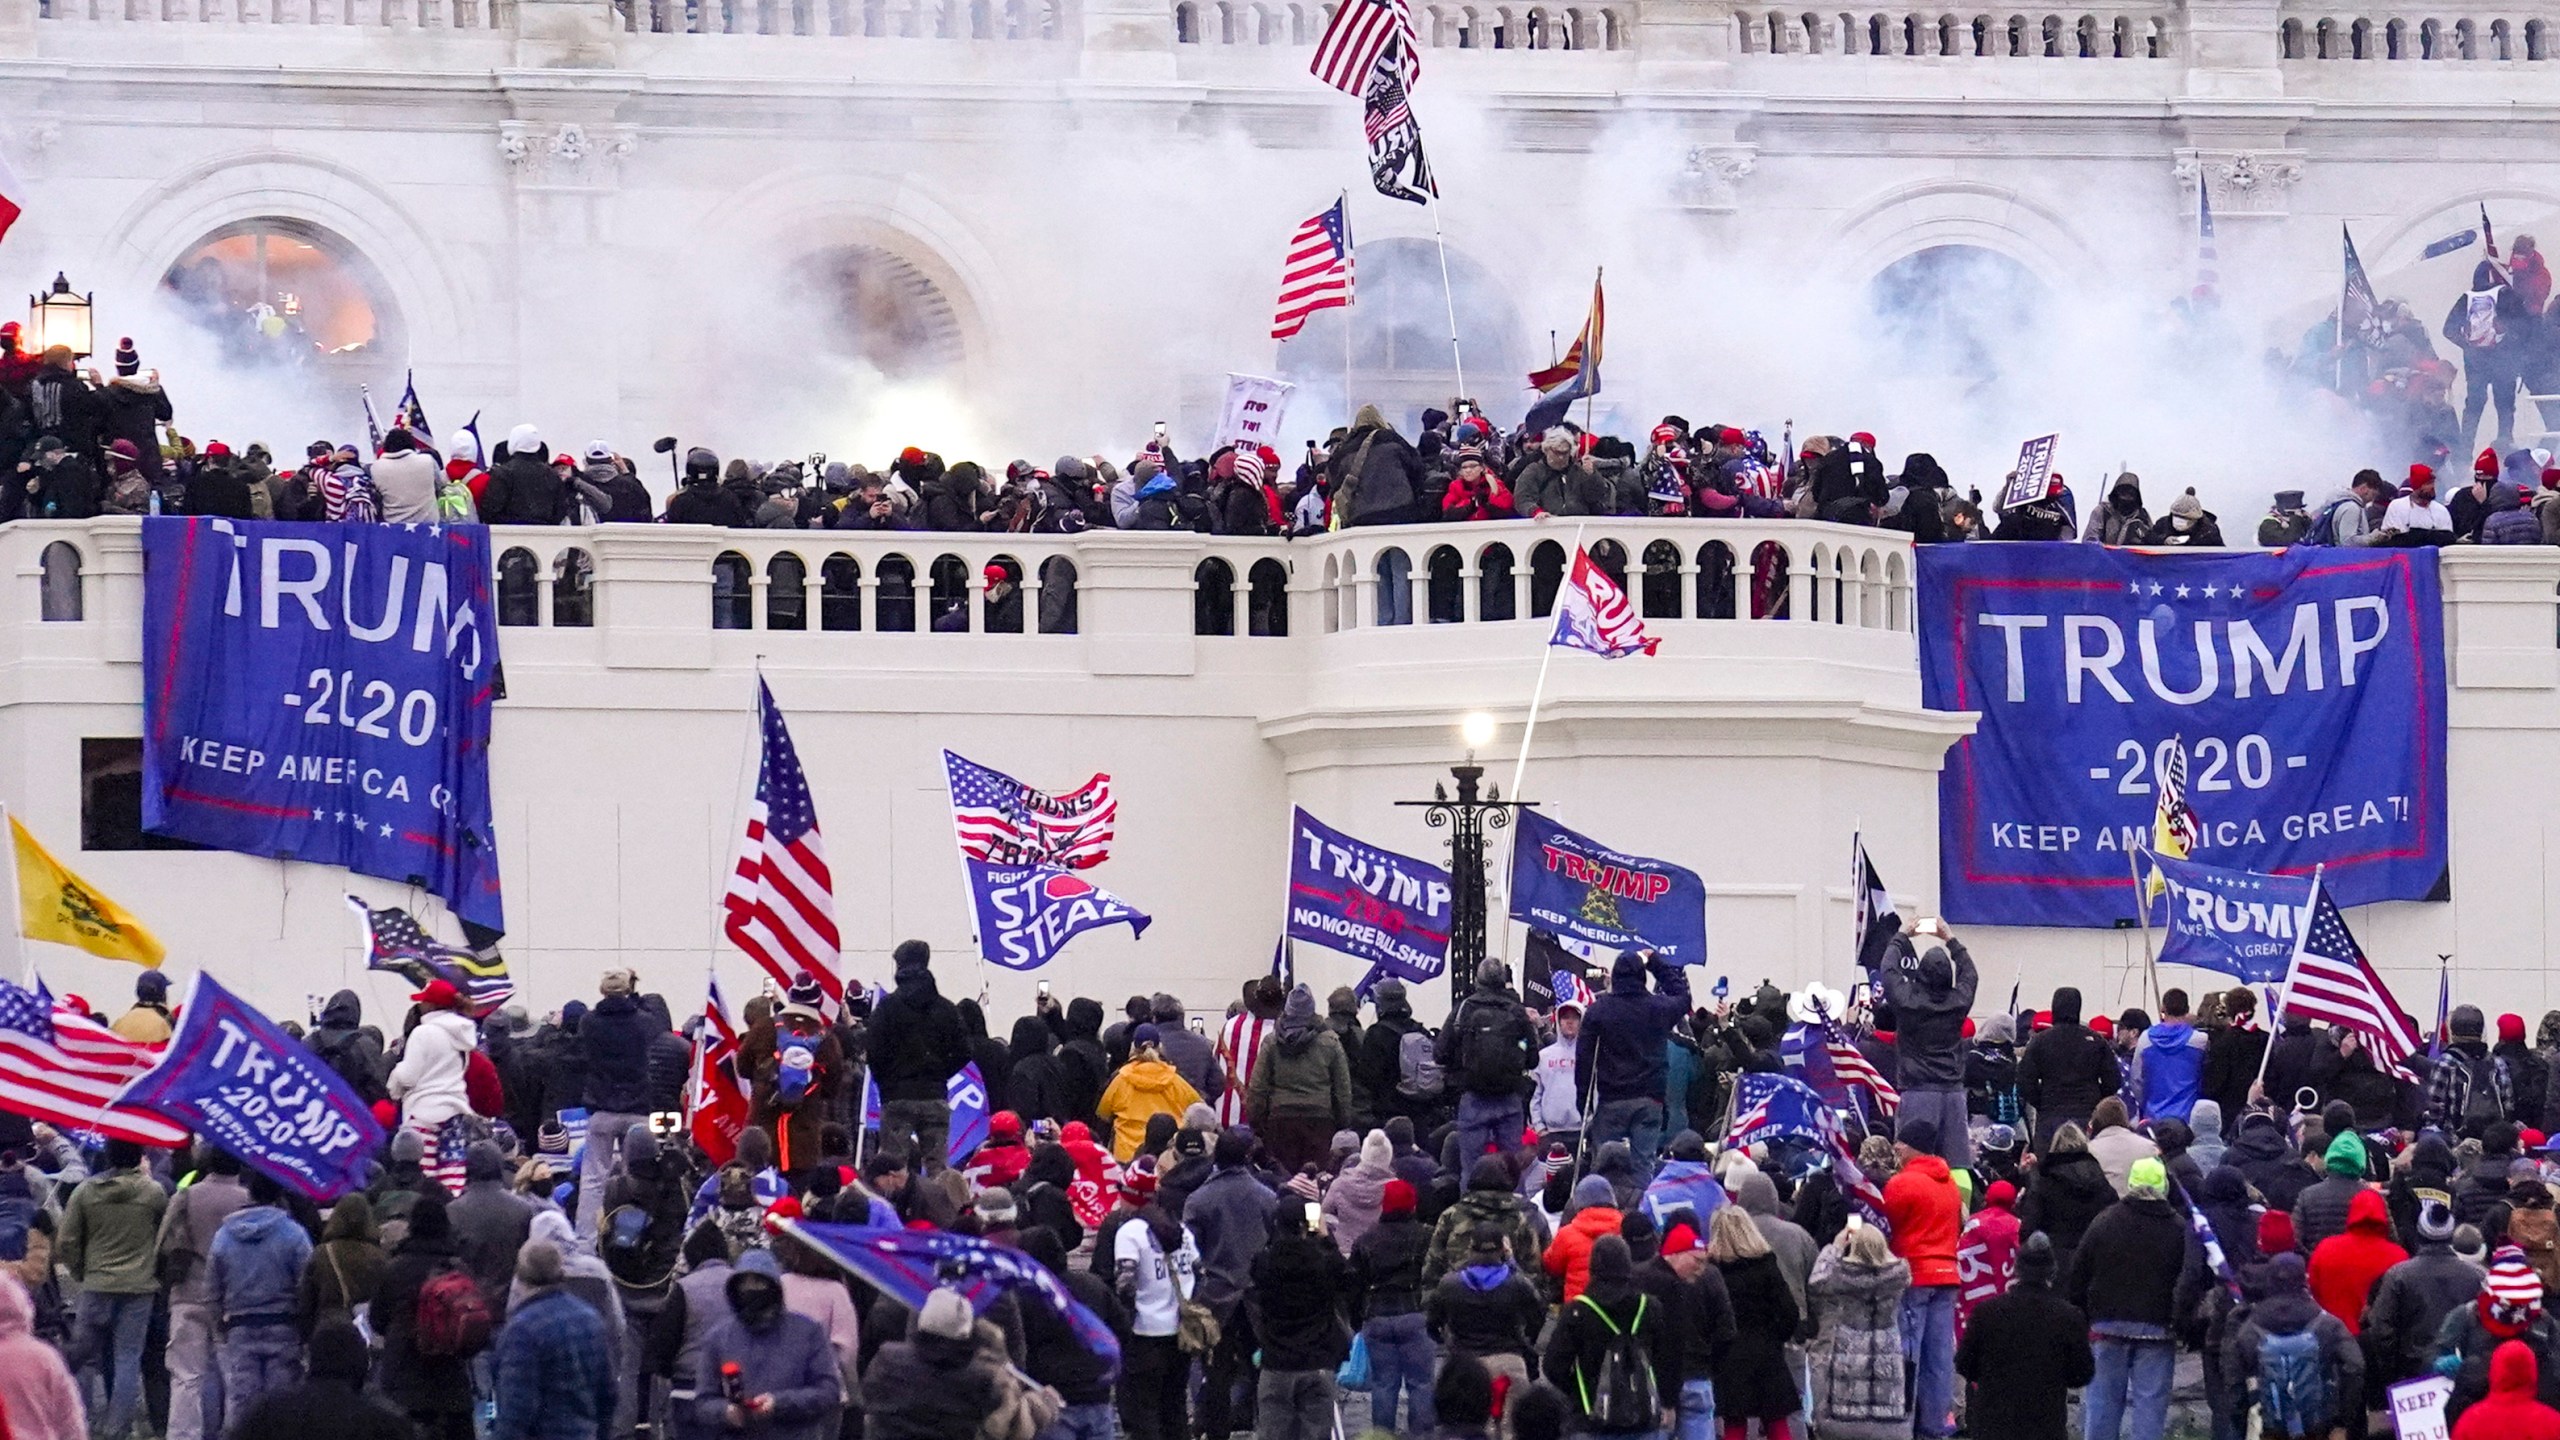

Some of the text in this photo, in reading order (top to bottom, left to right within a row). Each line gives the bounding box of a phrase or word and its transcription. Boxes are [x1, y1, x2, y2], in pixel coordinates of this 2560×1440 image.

[2026, 438, 2052, 497] TRUMP
[1979, 595, 2389, 705] TRUMP
[181, 735, 265, 775] KEEP
[278, 755, 411, 804] AMECA
[1992, 796, 2410, 851] KEEP AMICA GREAT!
[988, 870, 1030, 884] FIGHT
[1302, 827, 1452, 917] TRUMP
[1541, 843, 1671, 904] TRUMP
[998, 898, 1129, 966] STEAL
[1294, 907, 1440, 973] NO MORE BULLSHIT
[1531, 907, 1568, 926] KEEP
[1569, 920, 1631, 943] AMERICA
[2245, 944, 2284, 958] GREAT
[211, 1019, 361, 1155] TRUMP
[1737, 1123, 1783, 1149] KEEP
[2396, 1391, 2437, 1414] KEEP
